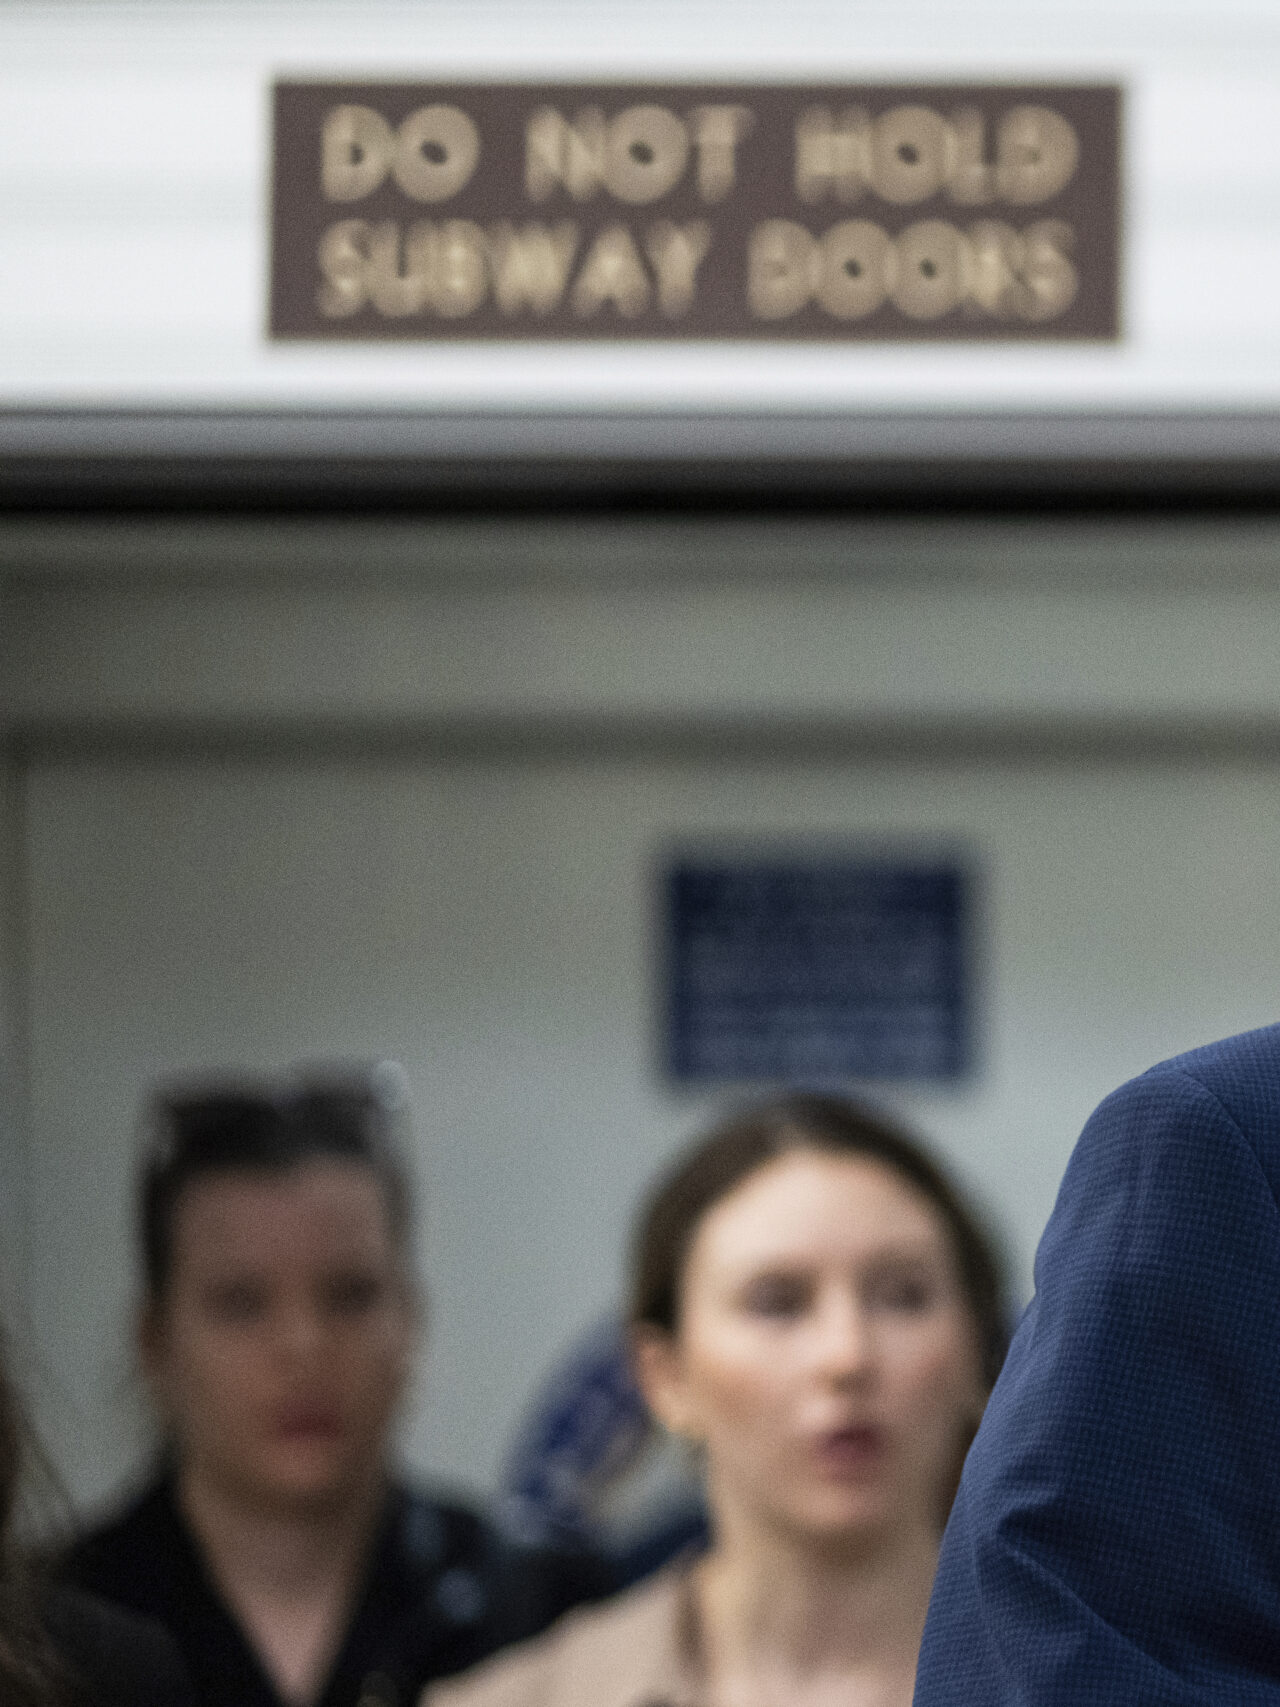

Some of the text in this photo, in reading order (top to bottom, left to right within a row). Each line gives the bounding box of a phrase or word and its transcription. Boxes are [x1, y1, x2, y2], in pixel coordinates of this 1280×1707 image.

[321, 103, 1079, 204] DO NOT HOLD
[318, 218, 1078, 320] SUBWAY DOORS
